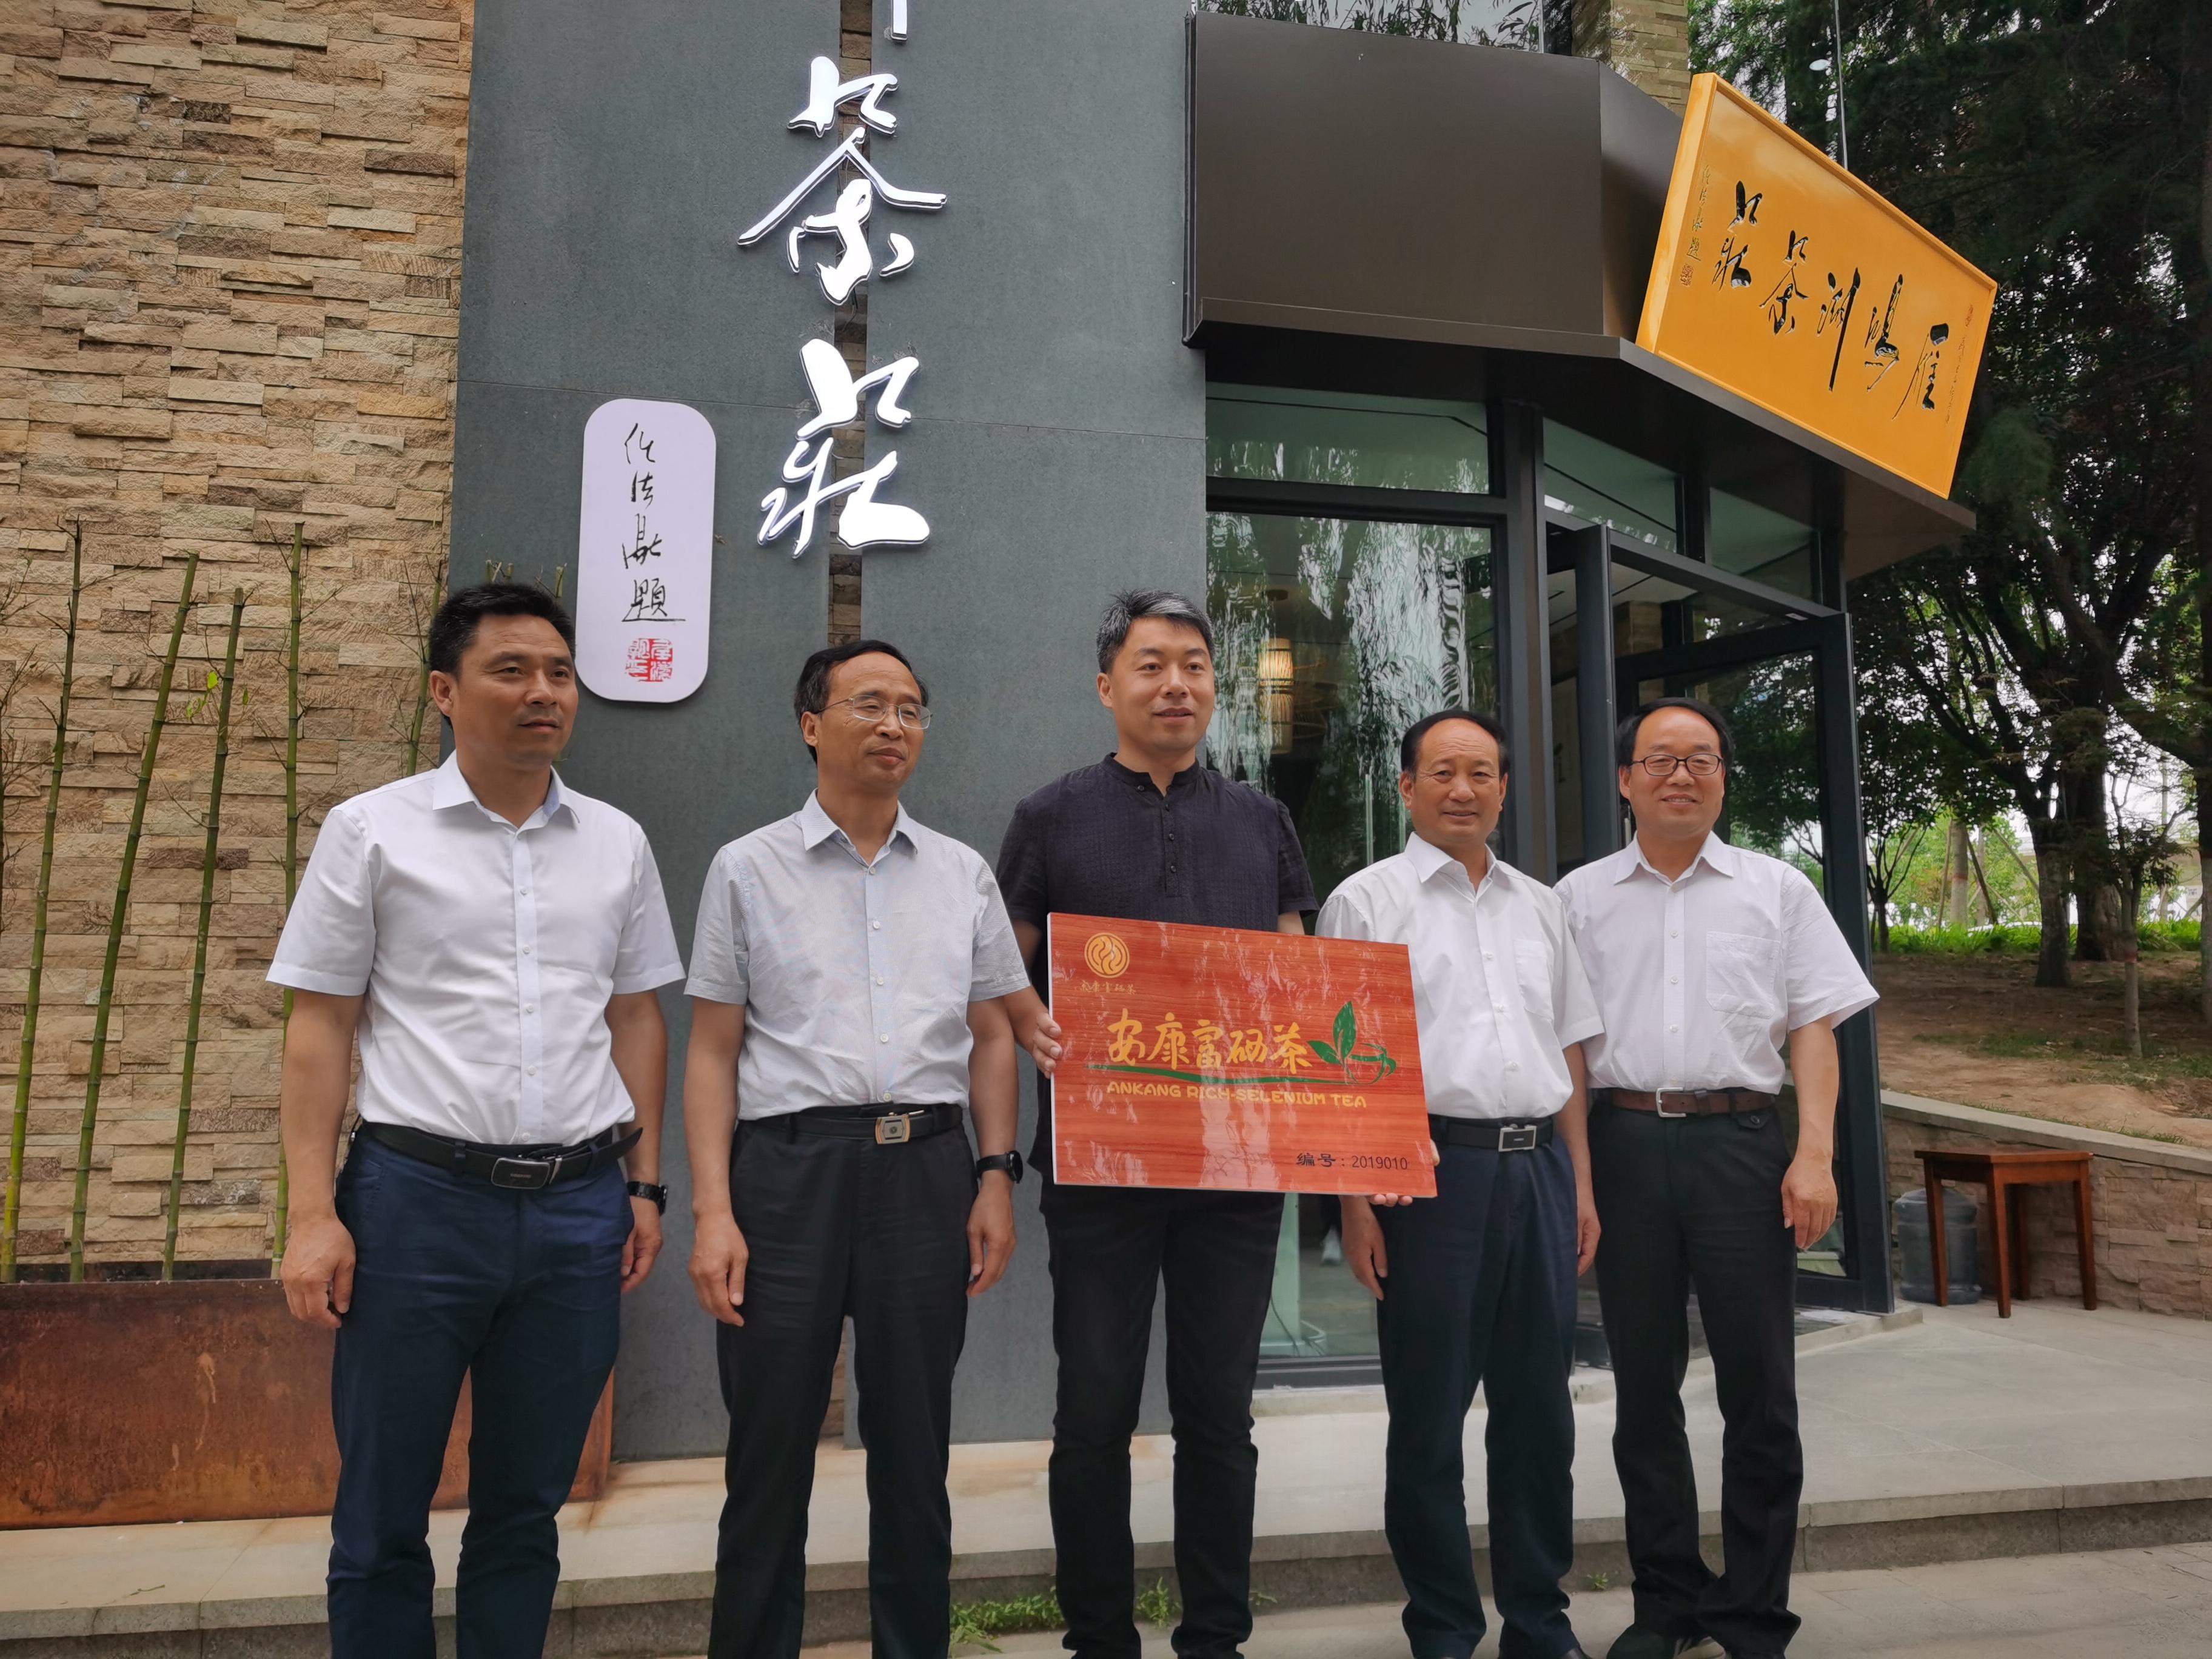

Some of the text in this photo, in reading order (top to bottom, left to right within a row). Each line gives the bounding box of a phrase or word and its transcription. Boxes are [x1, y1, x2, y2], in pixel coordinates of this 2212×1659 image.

[1107, 1007, 1313, 1074] 安康富硒茶
[1107, 1081, 1367, 1108] ANKANG RICH-SELENIUM TEA
